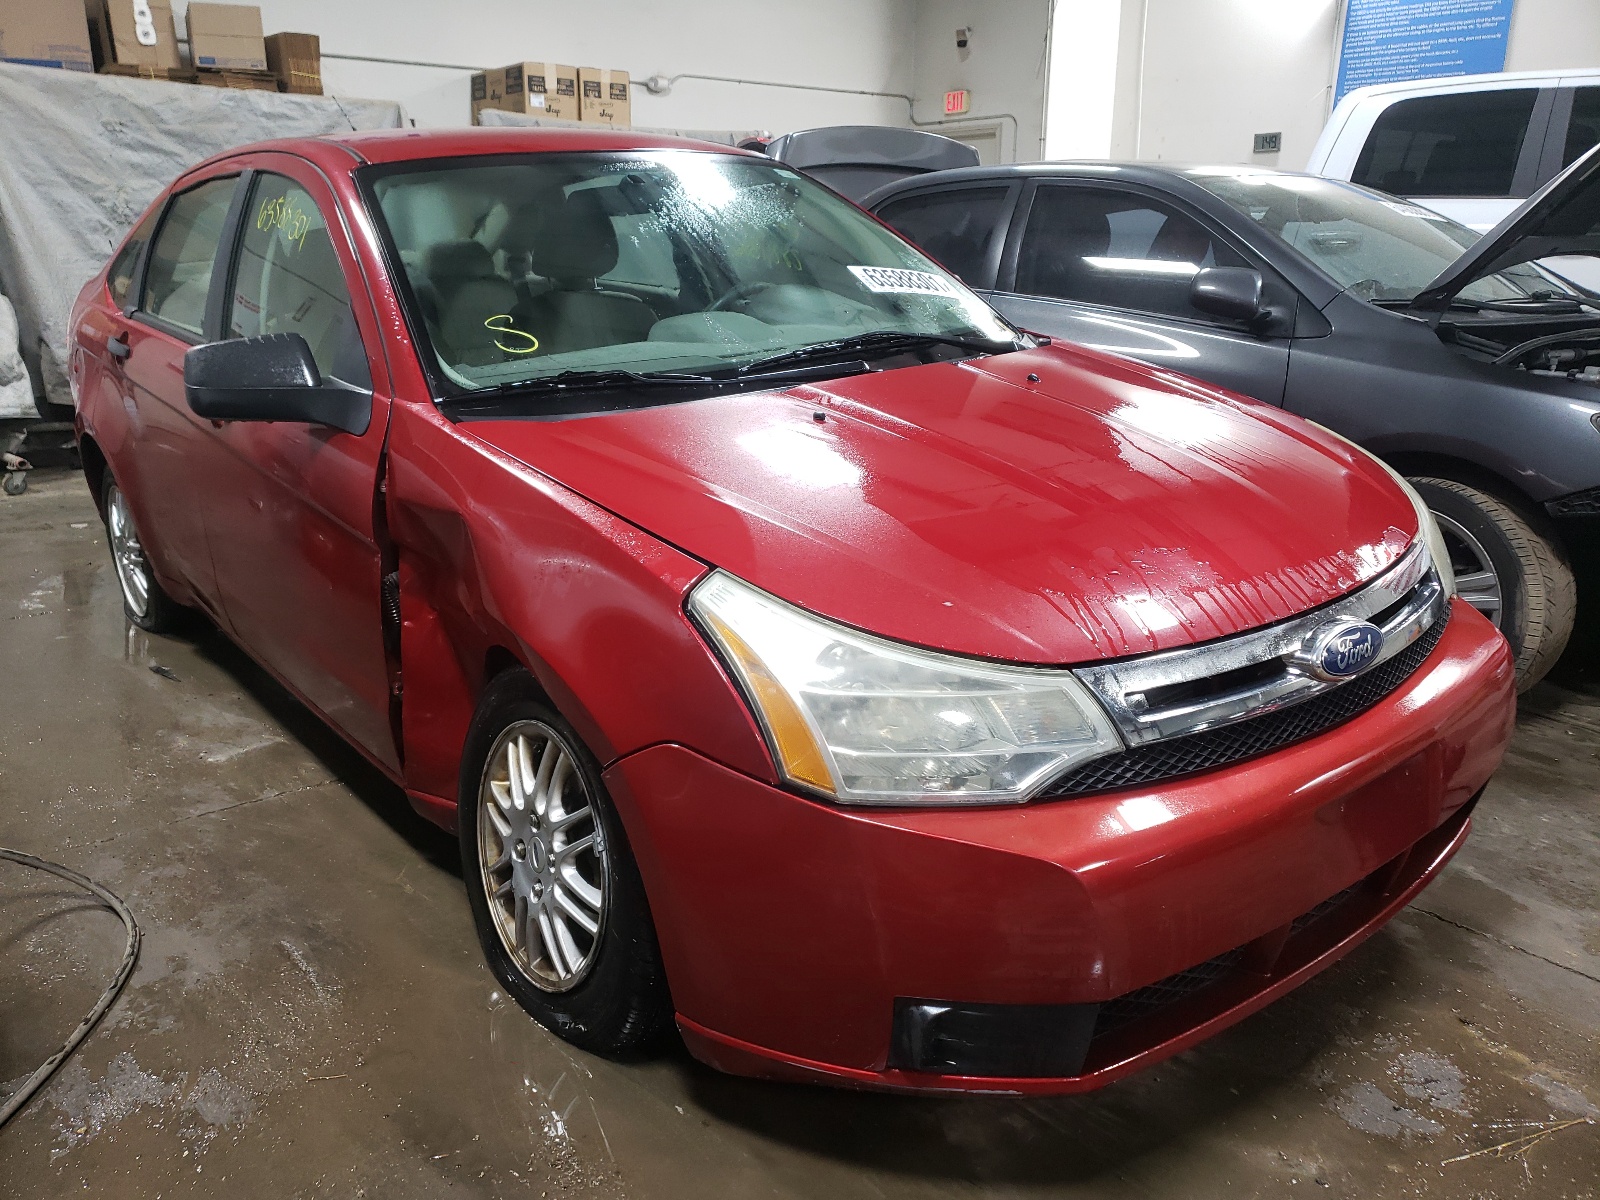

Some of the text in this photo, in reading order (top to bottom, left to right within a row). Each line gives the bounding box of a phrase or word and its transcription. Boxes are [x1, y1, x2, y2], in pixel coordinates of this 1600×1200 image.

[947, 92, 964, 112] EXIT
[1261, 135, 1277, 149] 149
[862, 268, 947, 293] 63588301
[1337, 631, 1374, 670] Ford
